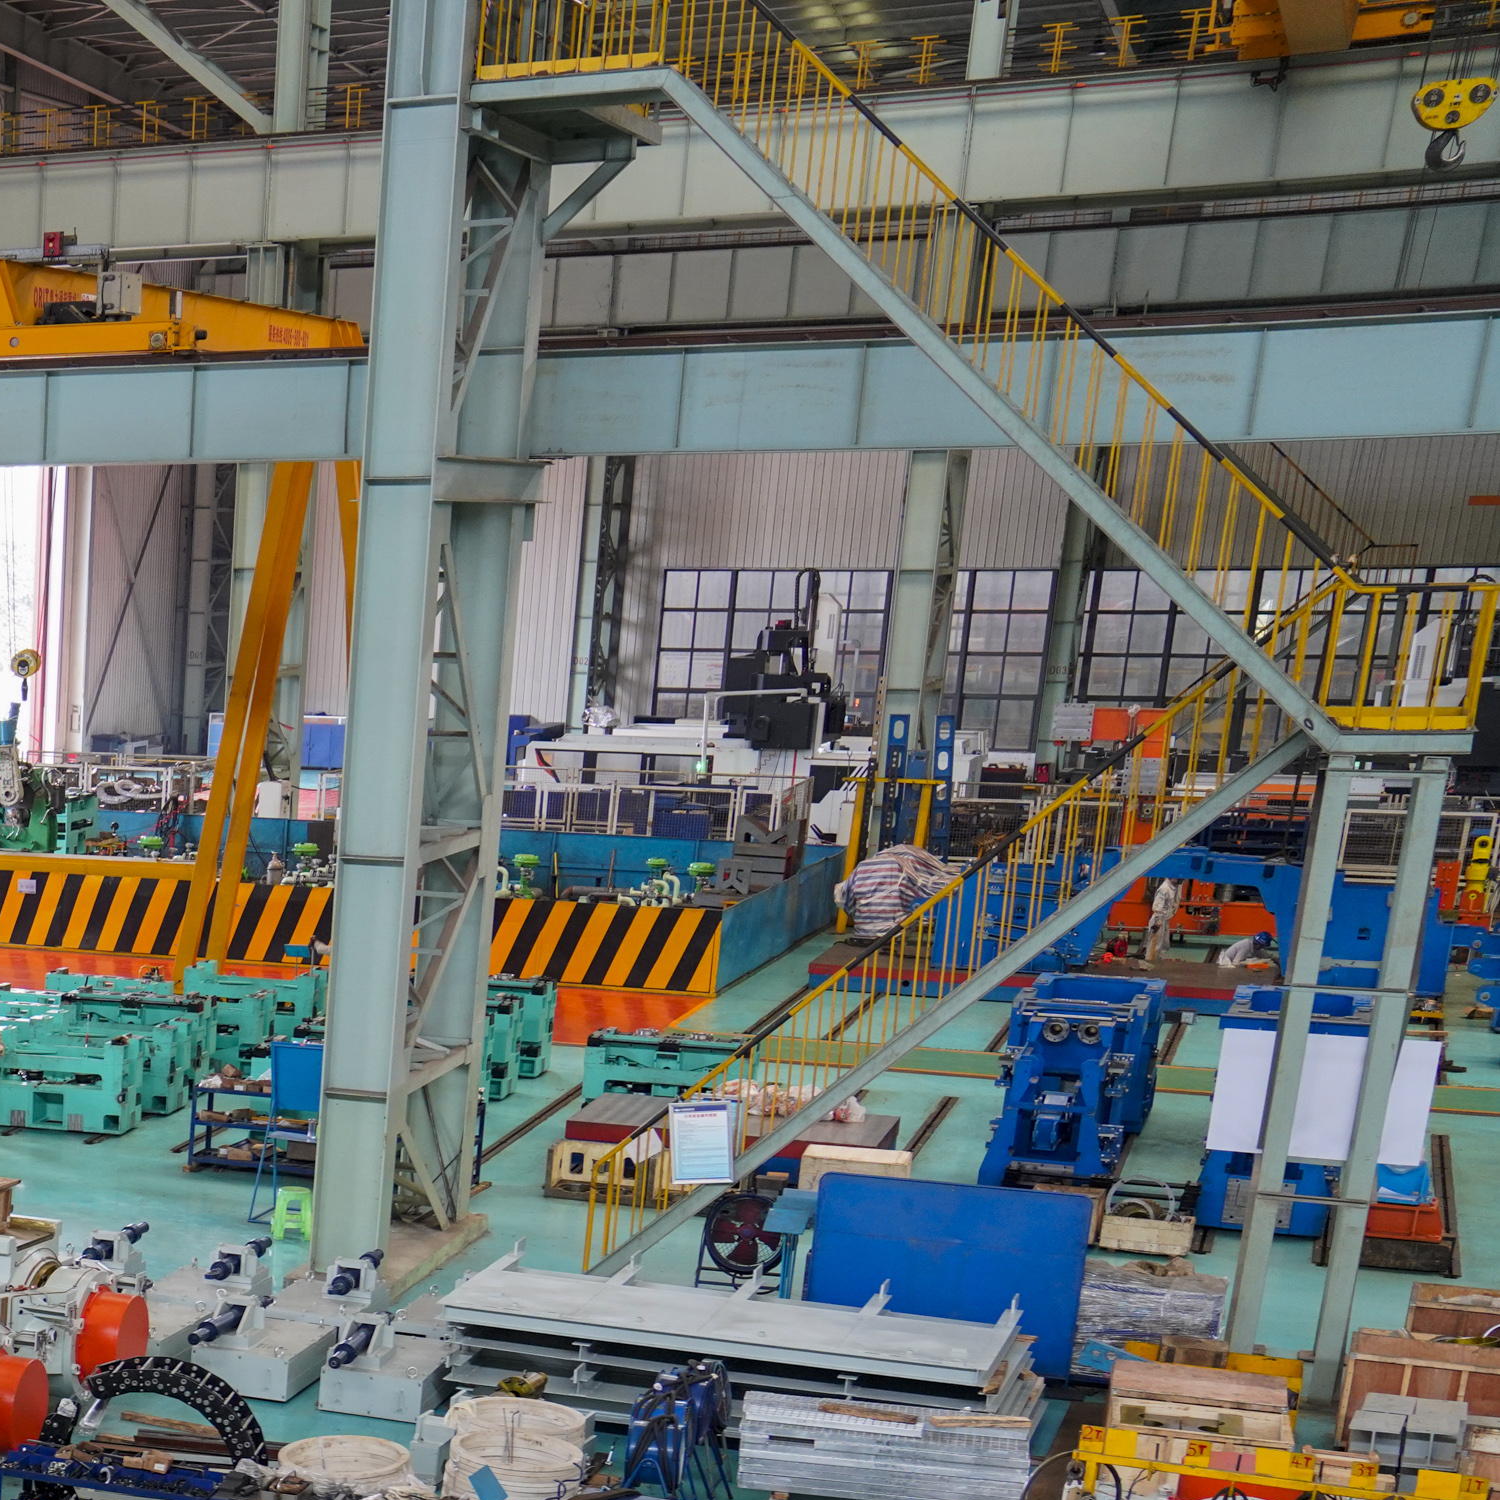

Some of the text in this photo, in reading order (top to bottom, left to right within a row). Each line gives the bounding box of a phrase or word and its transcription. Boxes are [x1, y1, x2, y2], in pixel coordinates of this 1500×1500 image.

[573, 657, 589, 665] D02
[1082, 1426, 1103, 1440] 2T
[1186, 1443, 1208, 1457] 5T
[1291, 1456, 1313, 1468] 4T
[1353, 1463, 1375, 1477] 3T
[1466, 1478, 1485, 1492] 1T
